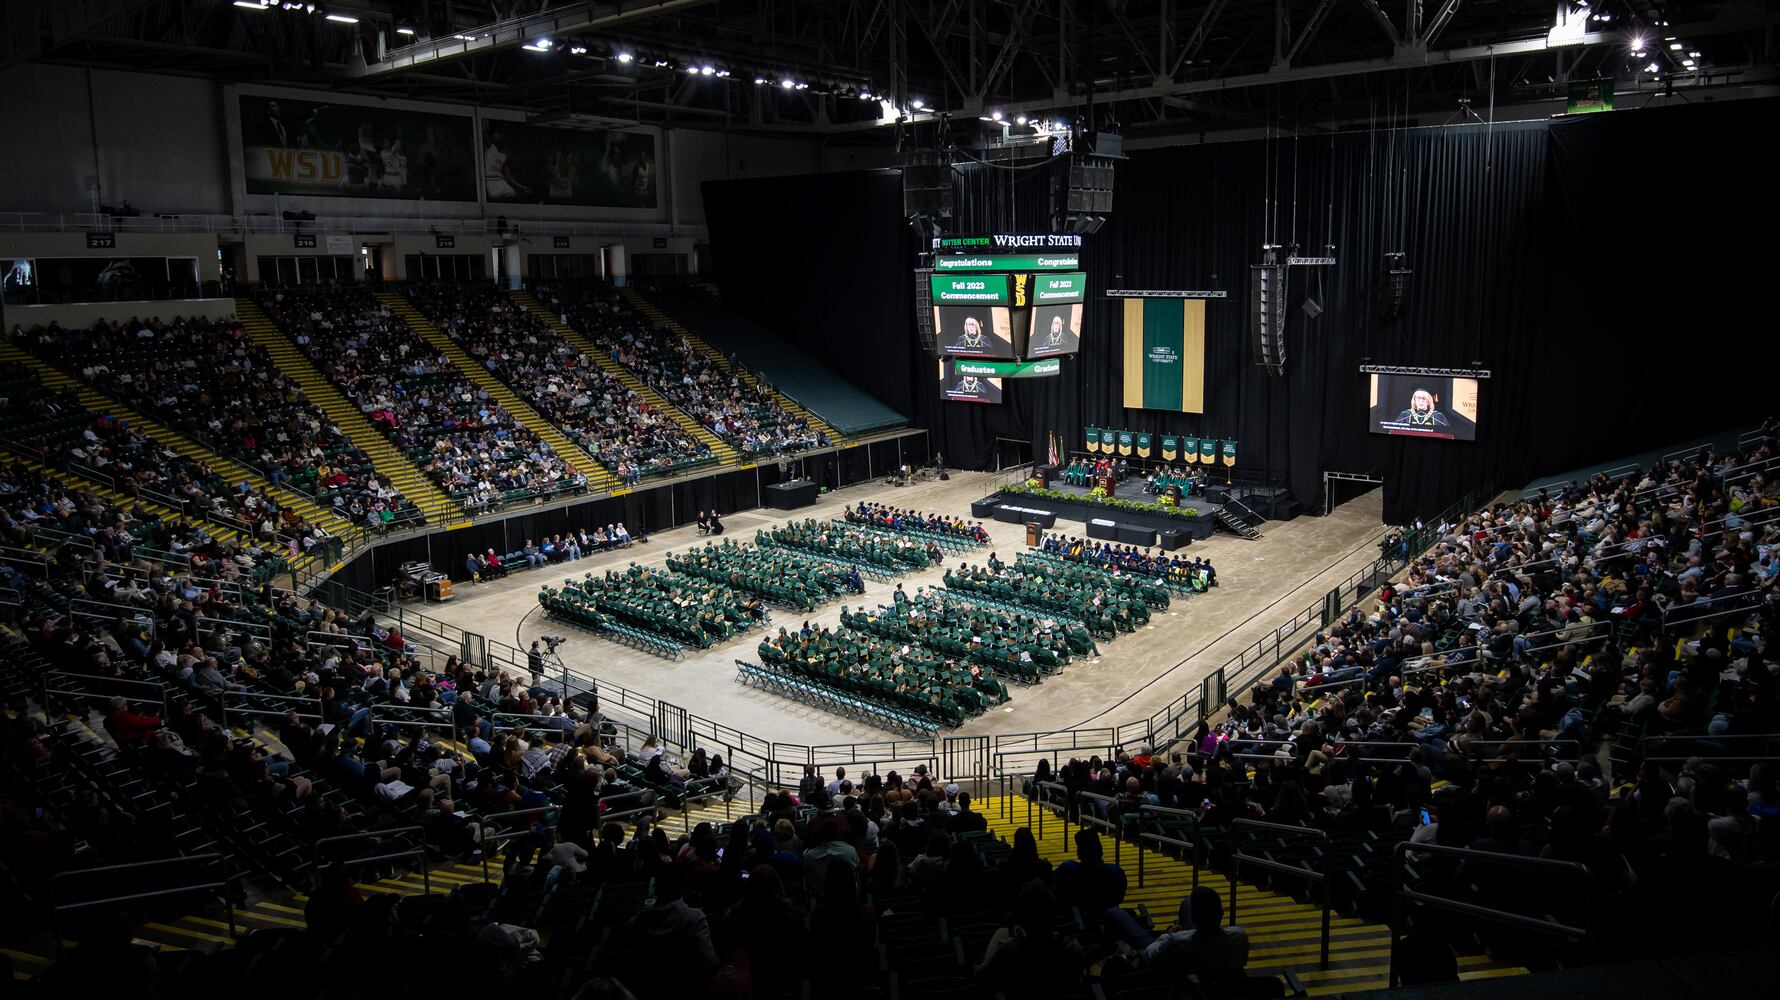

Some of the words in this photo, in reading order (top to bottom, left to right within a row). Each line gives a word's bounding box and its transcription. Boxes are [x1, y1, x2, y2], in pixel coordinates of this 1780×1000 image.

[264, 147, 344, 180] WSU
[91, 239, 112, 247] 217
[962, 238, 990, 246] CENTER
[940, 258, 992, 268] Congratulations
[952, 282, 965, 290] Fall
[967, 282, 985, 290] 2023
[1049, 281, 1059, 289] Fall
[1060, 280, 1072, 288] 2023
[941, 291, 999, 300] Commencement
[1039, 290, 1079, 299] Commencement
[960, 364, 996, 374] Graduates
